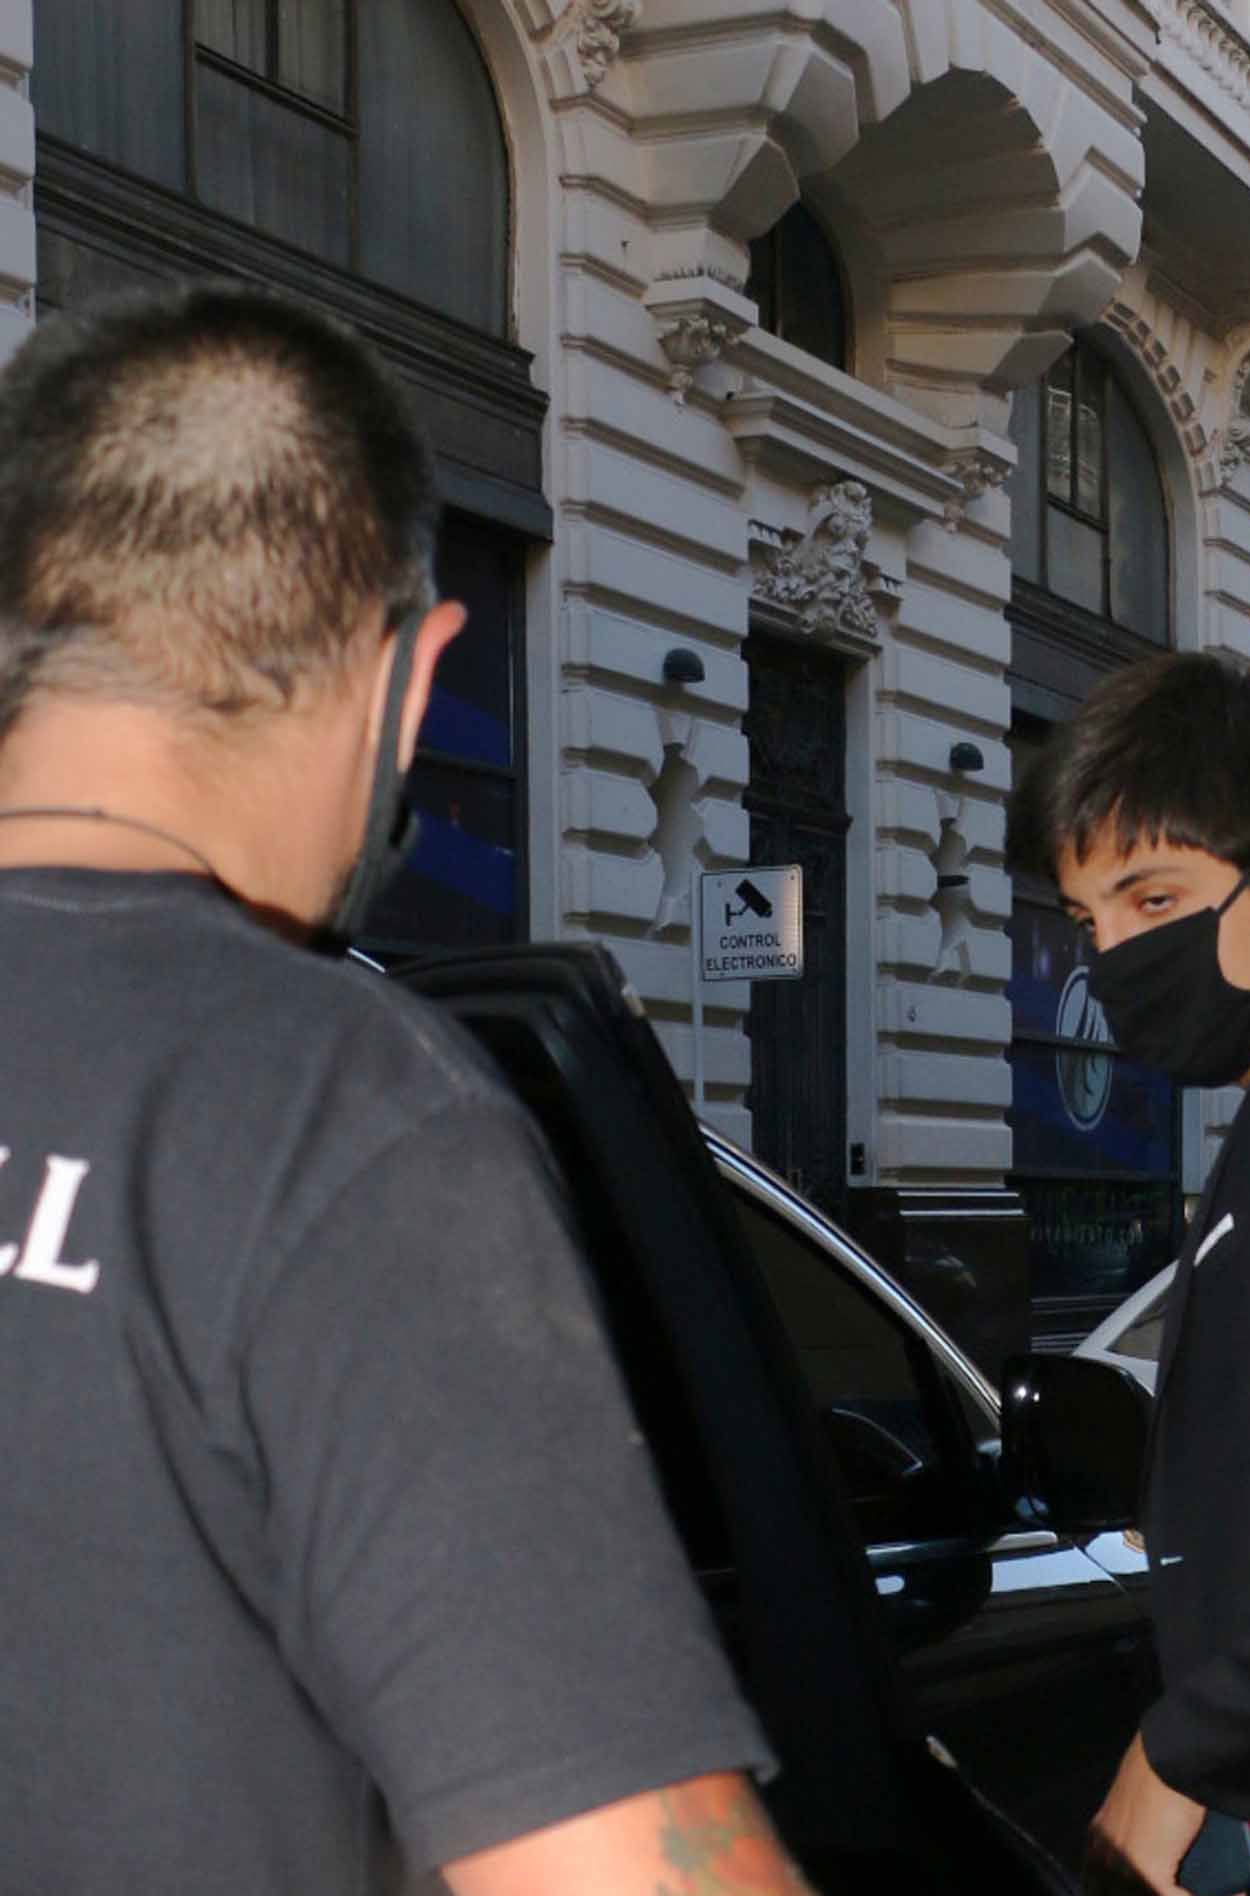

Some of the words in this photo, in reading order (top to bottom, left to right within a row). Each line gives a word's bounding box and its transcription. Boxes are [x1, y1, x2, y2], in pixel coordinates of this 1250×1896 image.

[719, 933, 782, 950] CONTROL
[706, 952, 797, 972] ELECTRONICO
[0, 1144, 100, 1293] L
